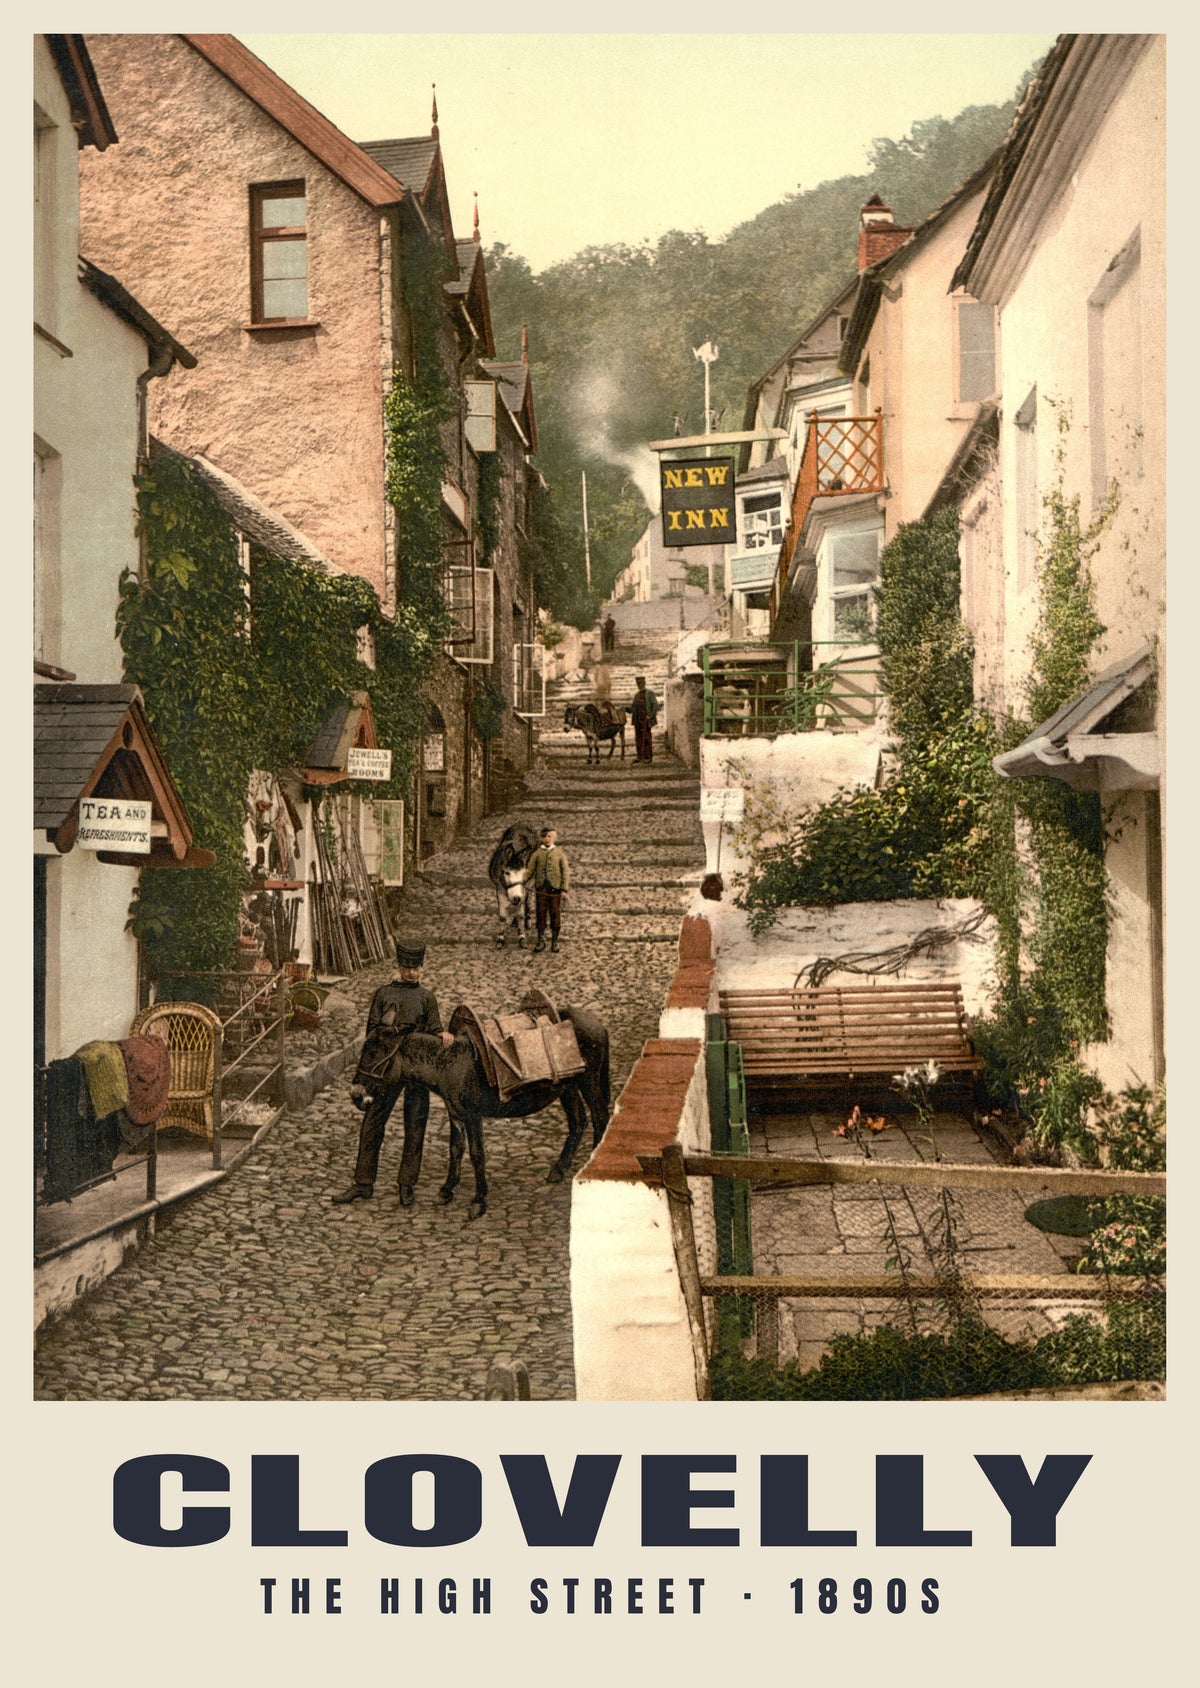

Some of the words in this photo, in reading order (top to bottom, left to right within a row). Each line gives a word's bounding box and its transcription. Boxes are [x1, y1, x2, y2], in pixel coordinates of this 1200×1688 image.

[663, 466, 729, 489] NEW
[668, 507, 729, 530] INN
[352, 769, 384, 777] ROOMS
[82, 803, 121, 820] TEA
[125, 808, 147, 819] AND
